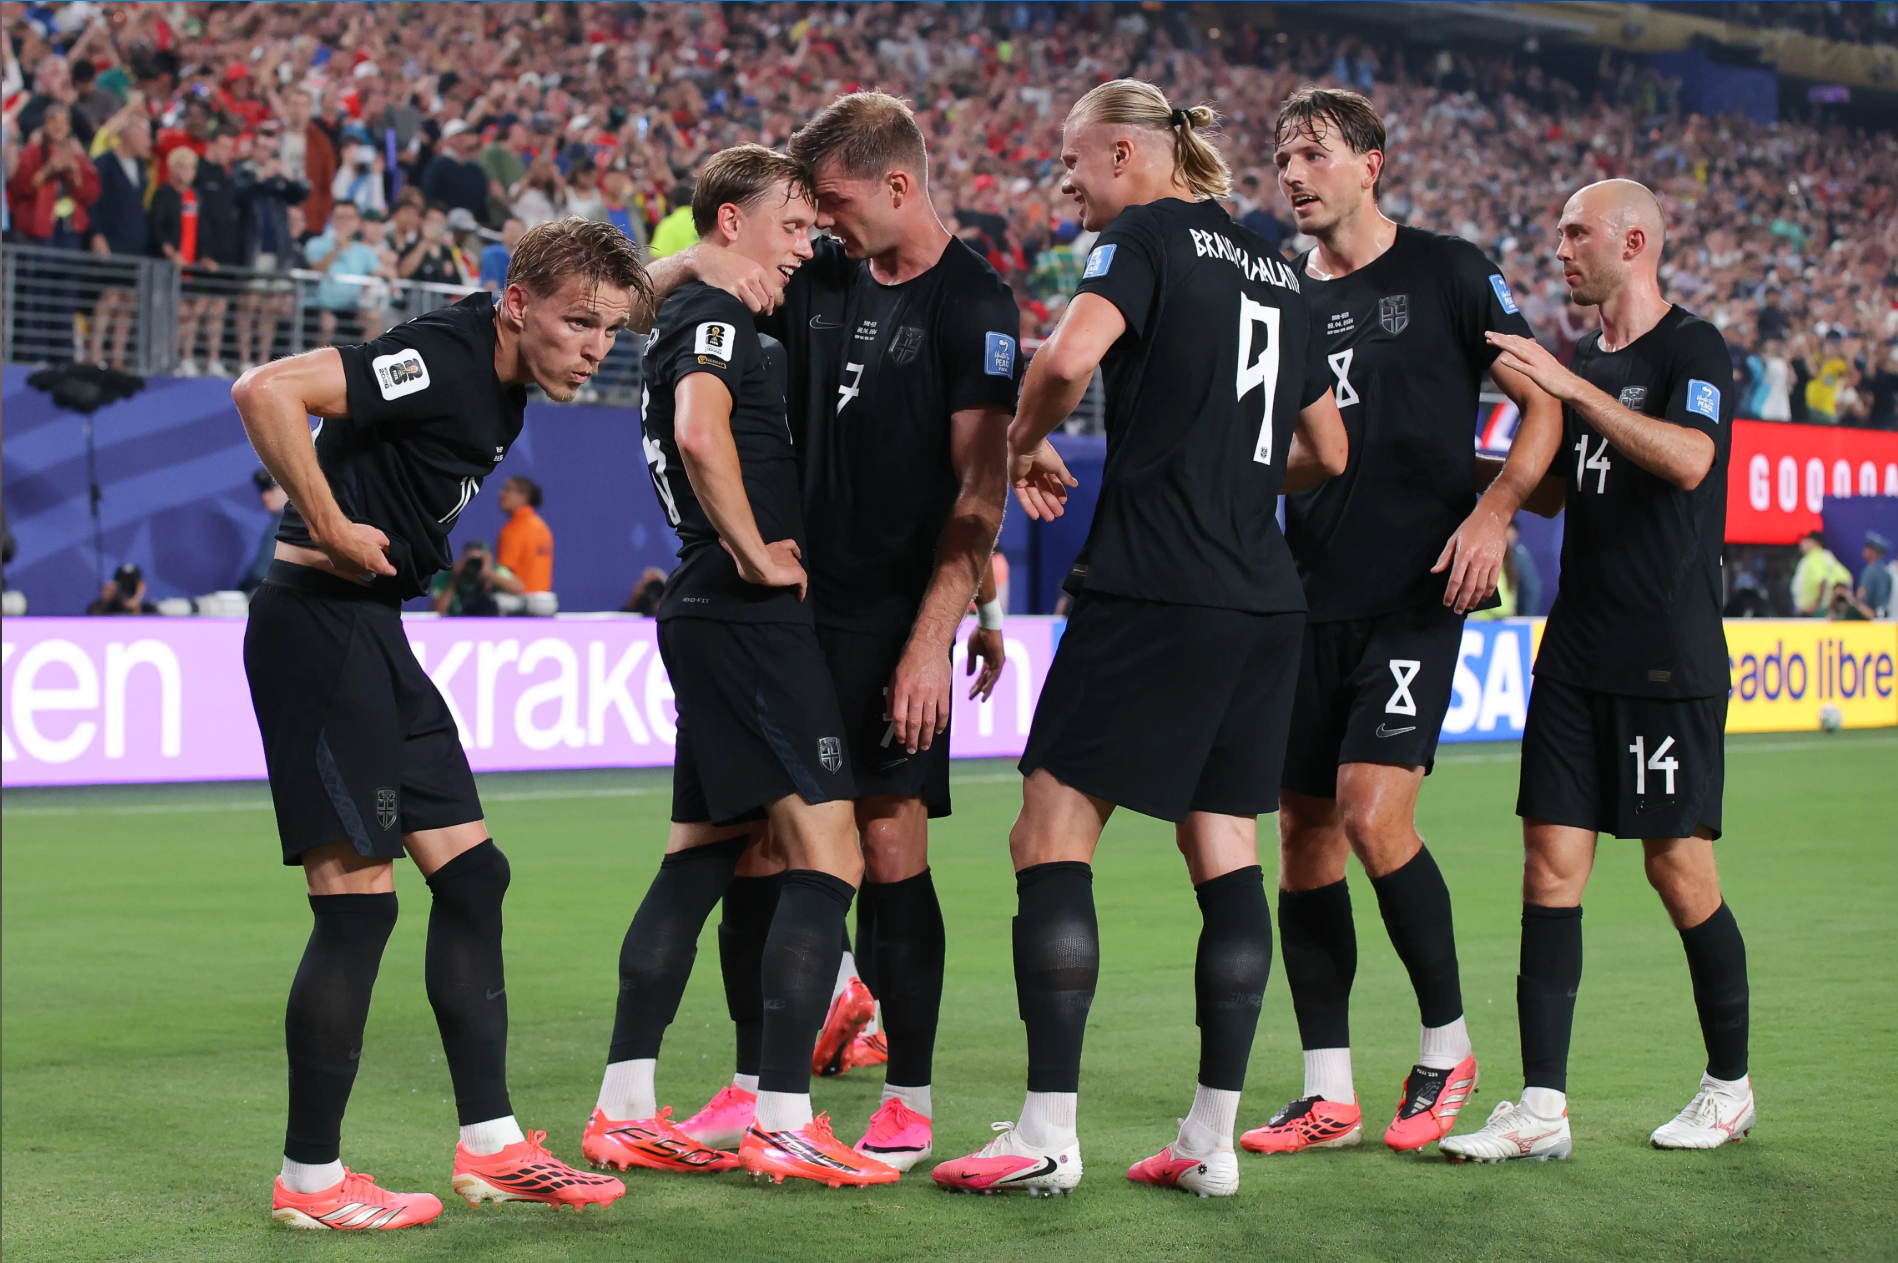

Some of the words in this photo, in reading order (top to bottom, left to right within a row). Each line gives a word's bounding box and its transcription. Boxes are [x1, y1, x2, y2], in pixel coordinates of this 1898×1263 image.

[836, 361, 865, 419] 7
[1236, 290, 1281, 466] 9
[1327, 348, 1360, 409] 8
[1574, 434, 1611, 494] 14
[1385, 659, 1421, 716] 8
[1729, 639, 1807, 700] ado
[1818, 639, 1894, 699] libre
[1629, 735, 1679, 794] 14
